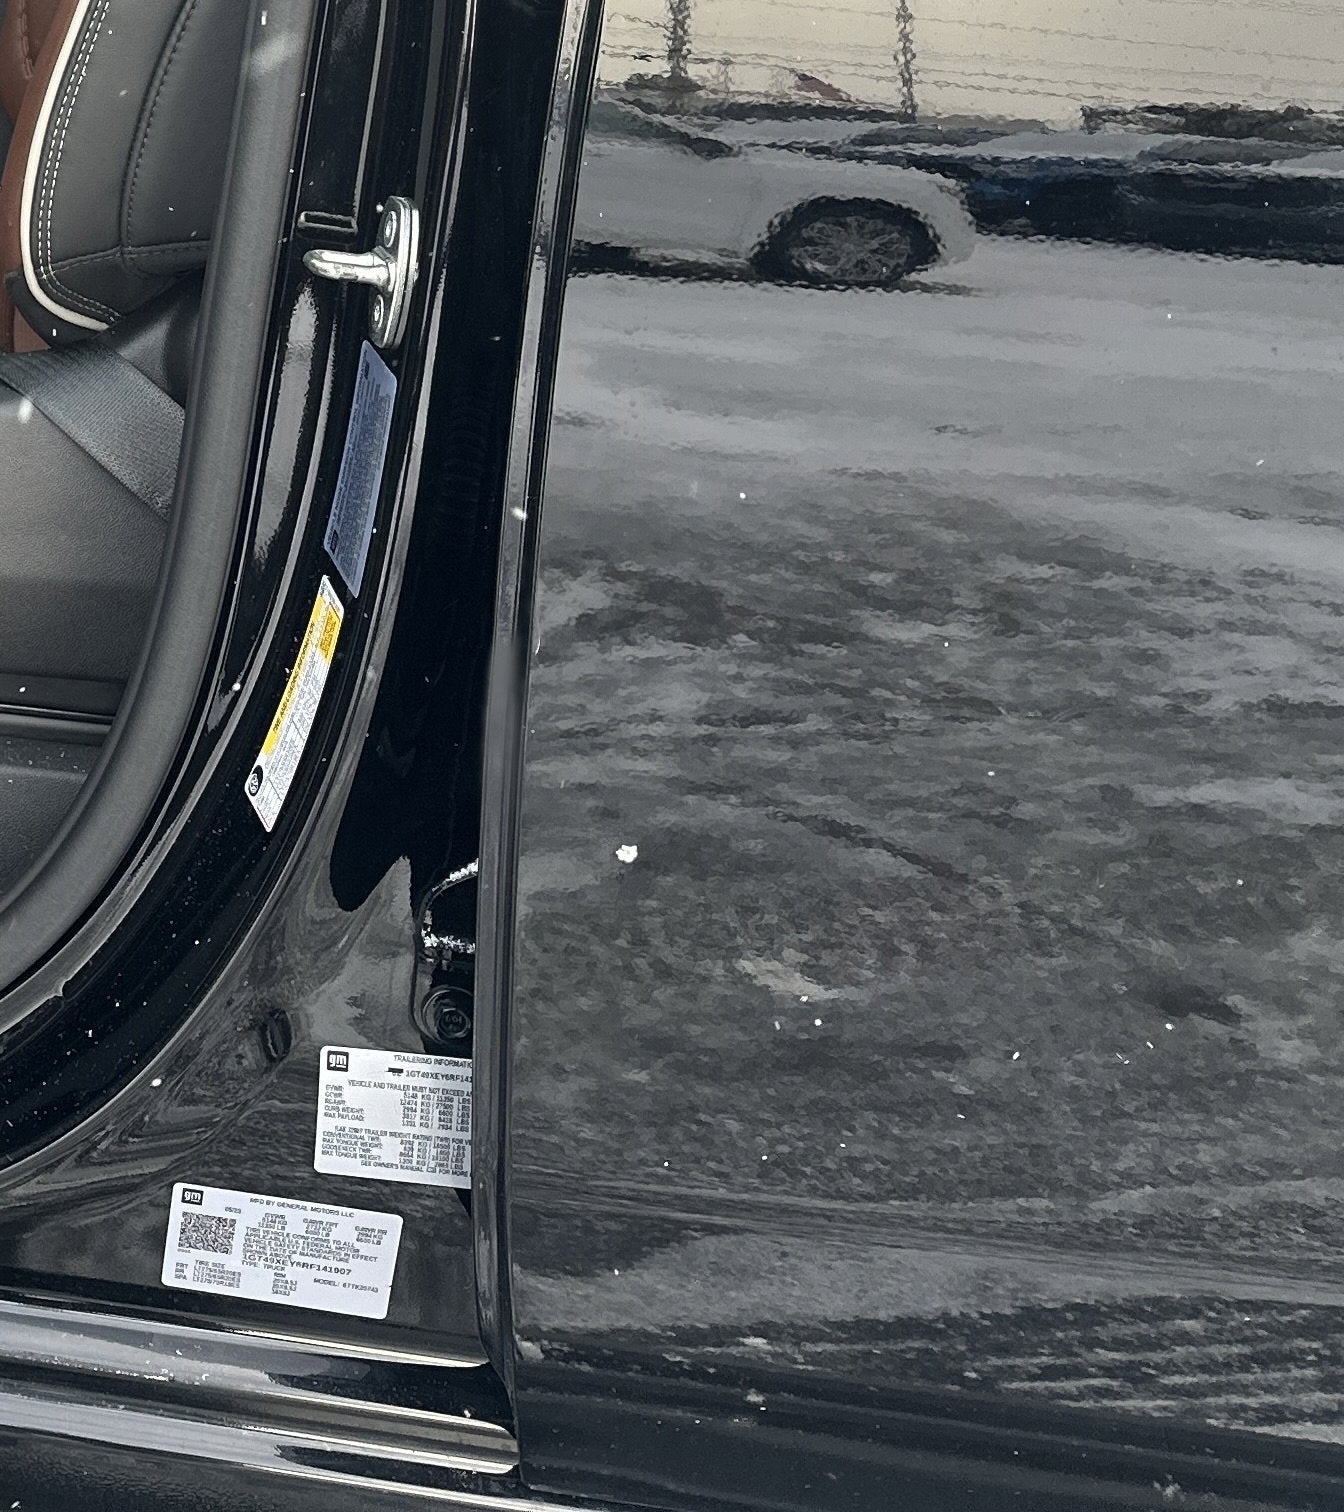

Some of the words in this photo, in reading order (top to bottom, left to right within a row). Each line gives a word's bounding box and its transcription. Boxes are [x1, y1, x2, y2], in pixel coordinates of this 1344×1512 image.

[329, 1054, 347, 1068] gm
[434, 1058, 472, 1068] INFORMATIO
[184, 1191, 202, 1203] gm
